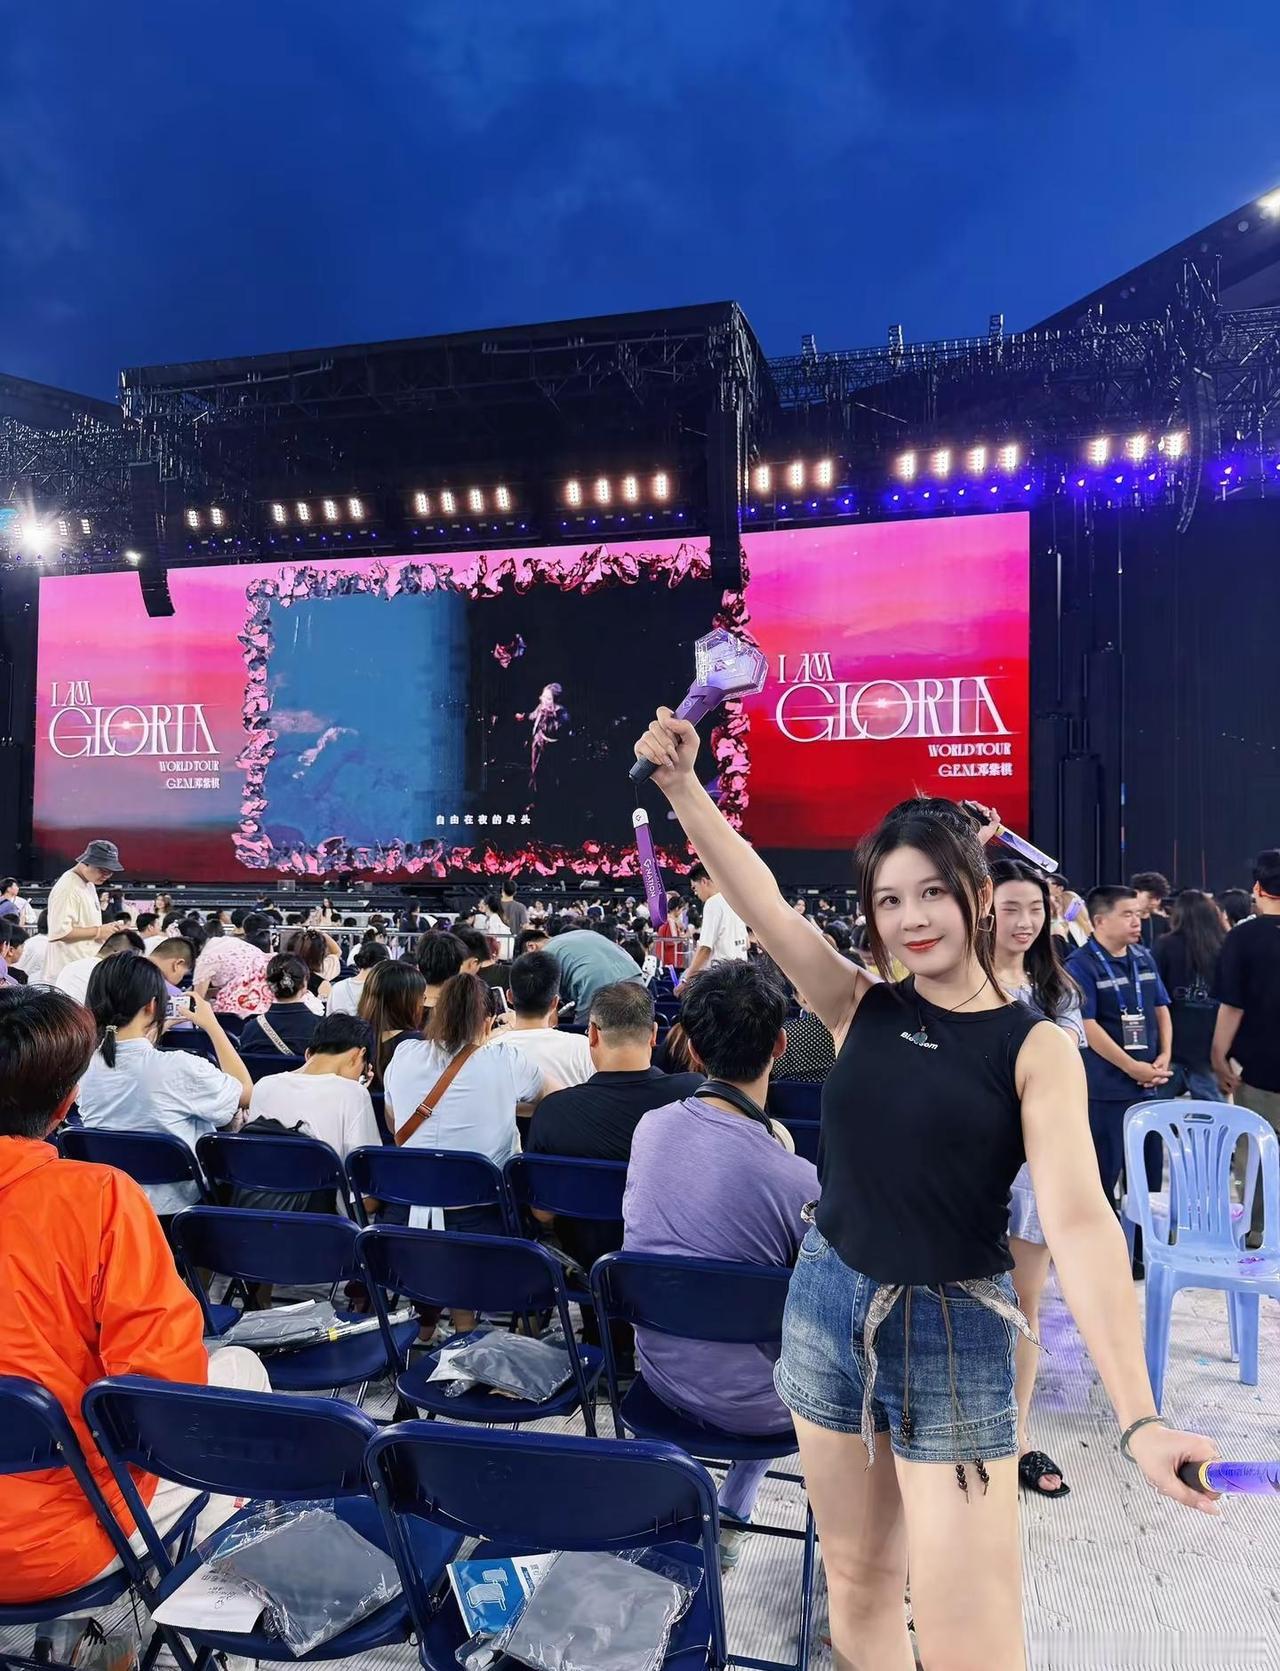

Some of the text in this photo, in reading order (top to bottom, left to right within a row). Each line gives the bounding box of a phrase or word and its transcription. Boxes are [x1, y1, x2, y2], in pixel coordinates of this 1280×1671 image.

[777, 652, 836, 684] I AM
[51, 680, 93, 707] I AM
[775, 676, 1013, 743] GLORIA
[49, 703, 221, 758] GLORIA
[928, 742, 1012, 758] WORLD TOUR
[159, 760, 219, 772] WORLD TOUR
[436, 814, 531, 826] 自由在夜的尽头
